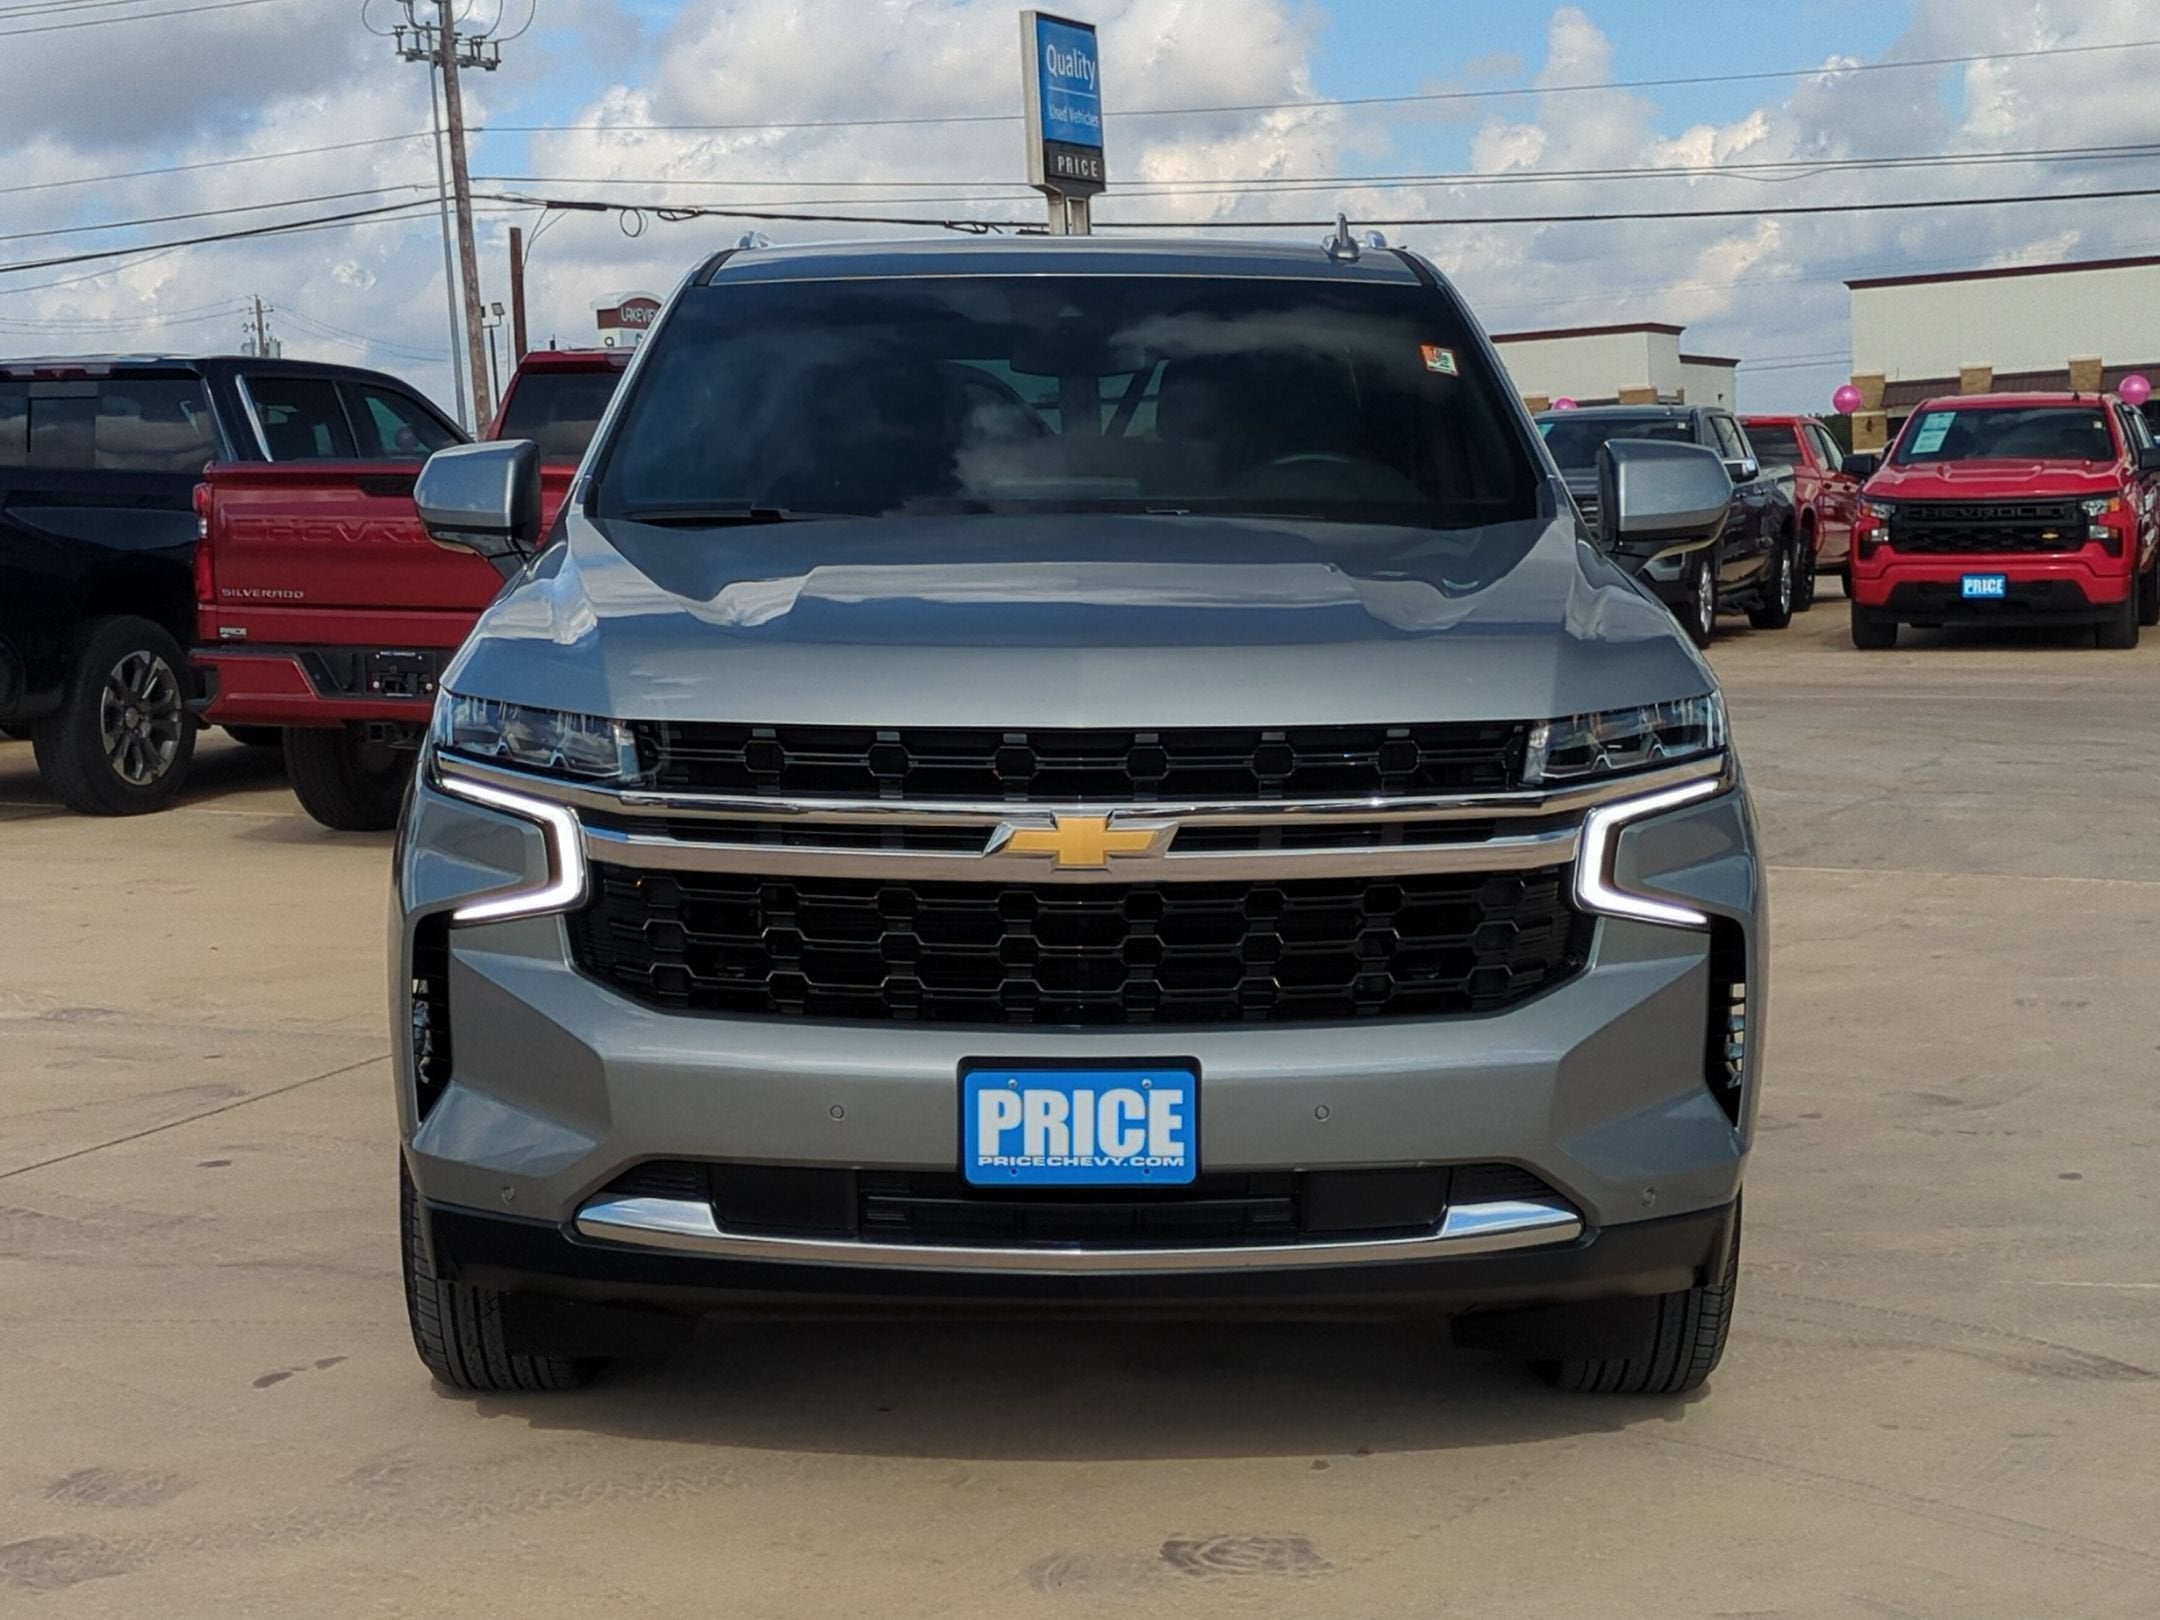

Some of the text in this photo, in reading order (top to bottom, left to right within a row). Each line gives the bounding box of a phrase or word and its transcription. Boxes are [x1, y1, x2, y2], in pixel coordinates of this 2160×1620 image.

[1046, 44, 1096, 90] Quality
[1050, 104, 1100, 127] Used Vehicles
[1057, 155, 1098, 178] PRICE
[620, 306, 657, 323] LAKEVIE
[232, 517, 432, 543] CHEVR
[221, 588, 305, 599] SILVERADO
[1964, 579, 2004, 594] PRICE
[978, 1088, 1185, 1157] PRICE
[978, 1156, 1185, 1167] PRICECHEVY.COM
